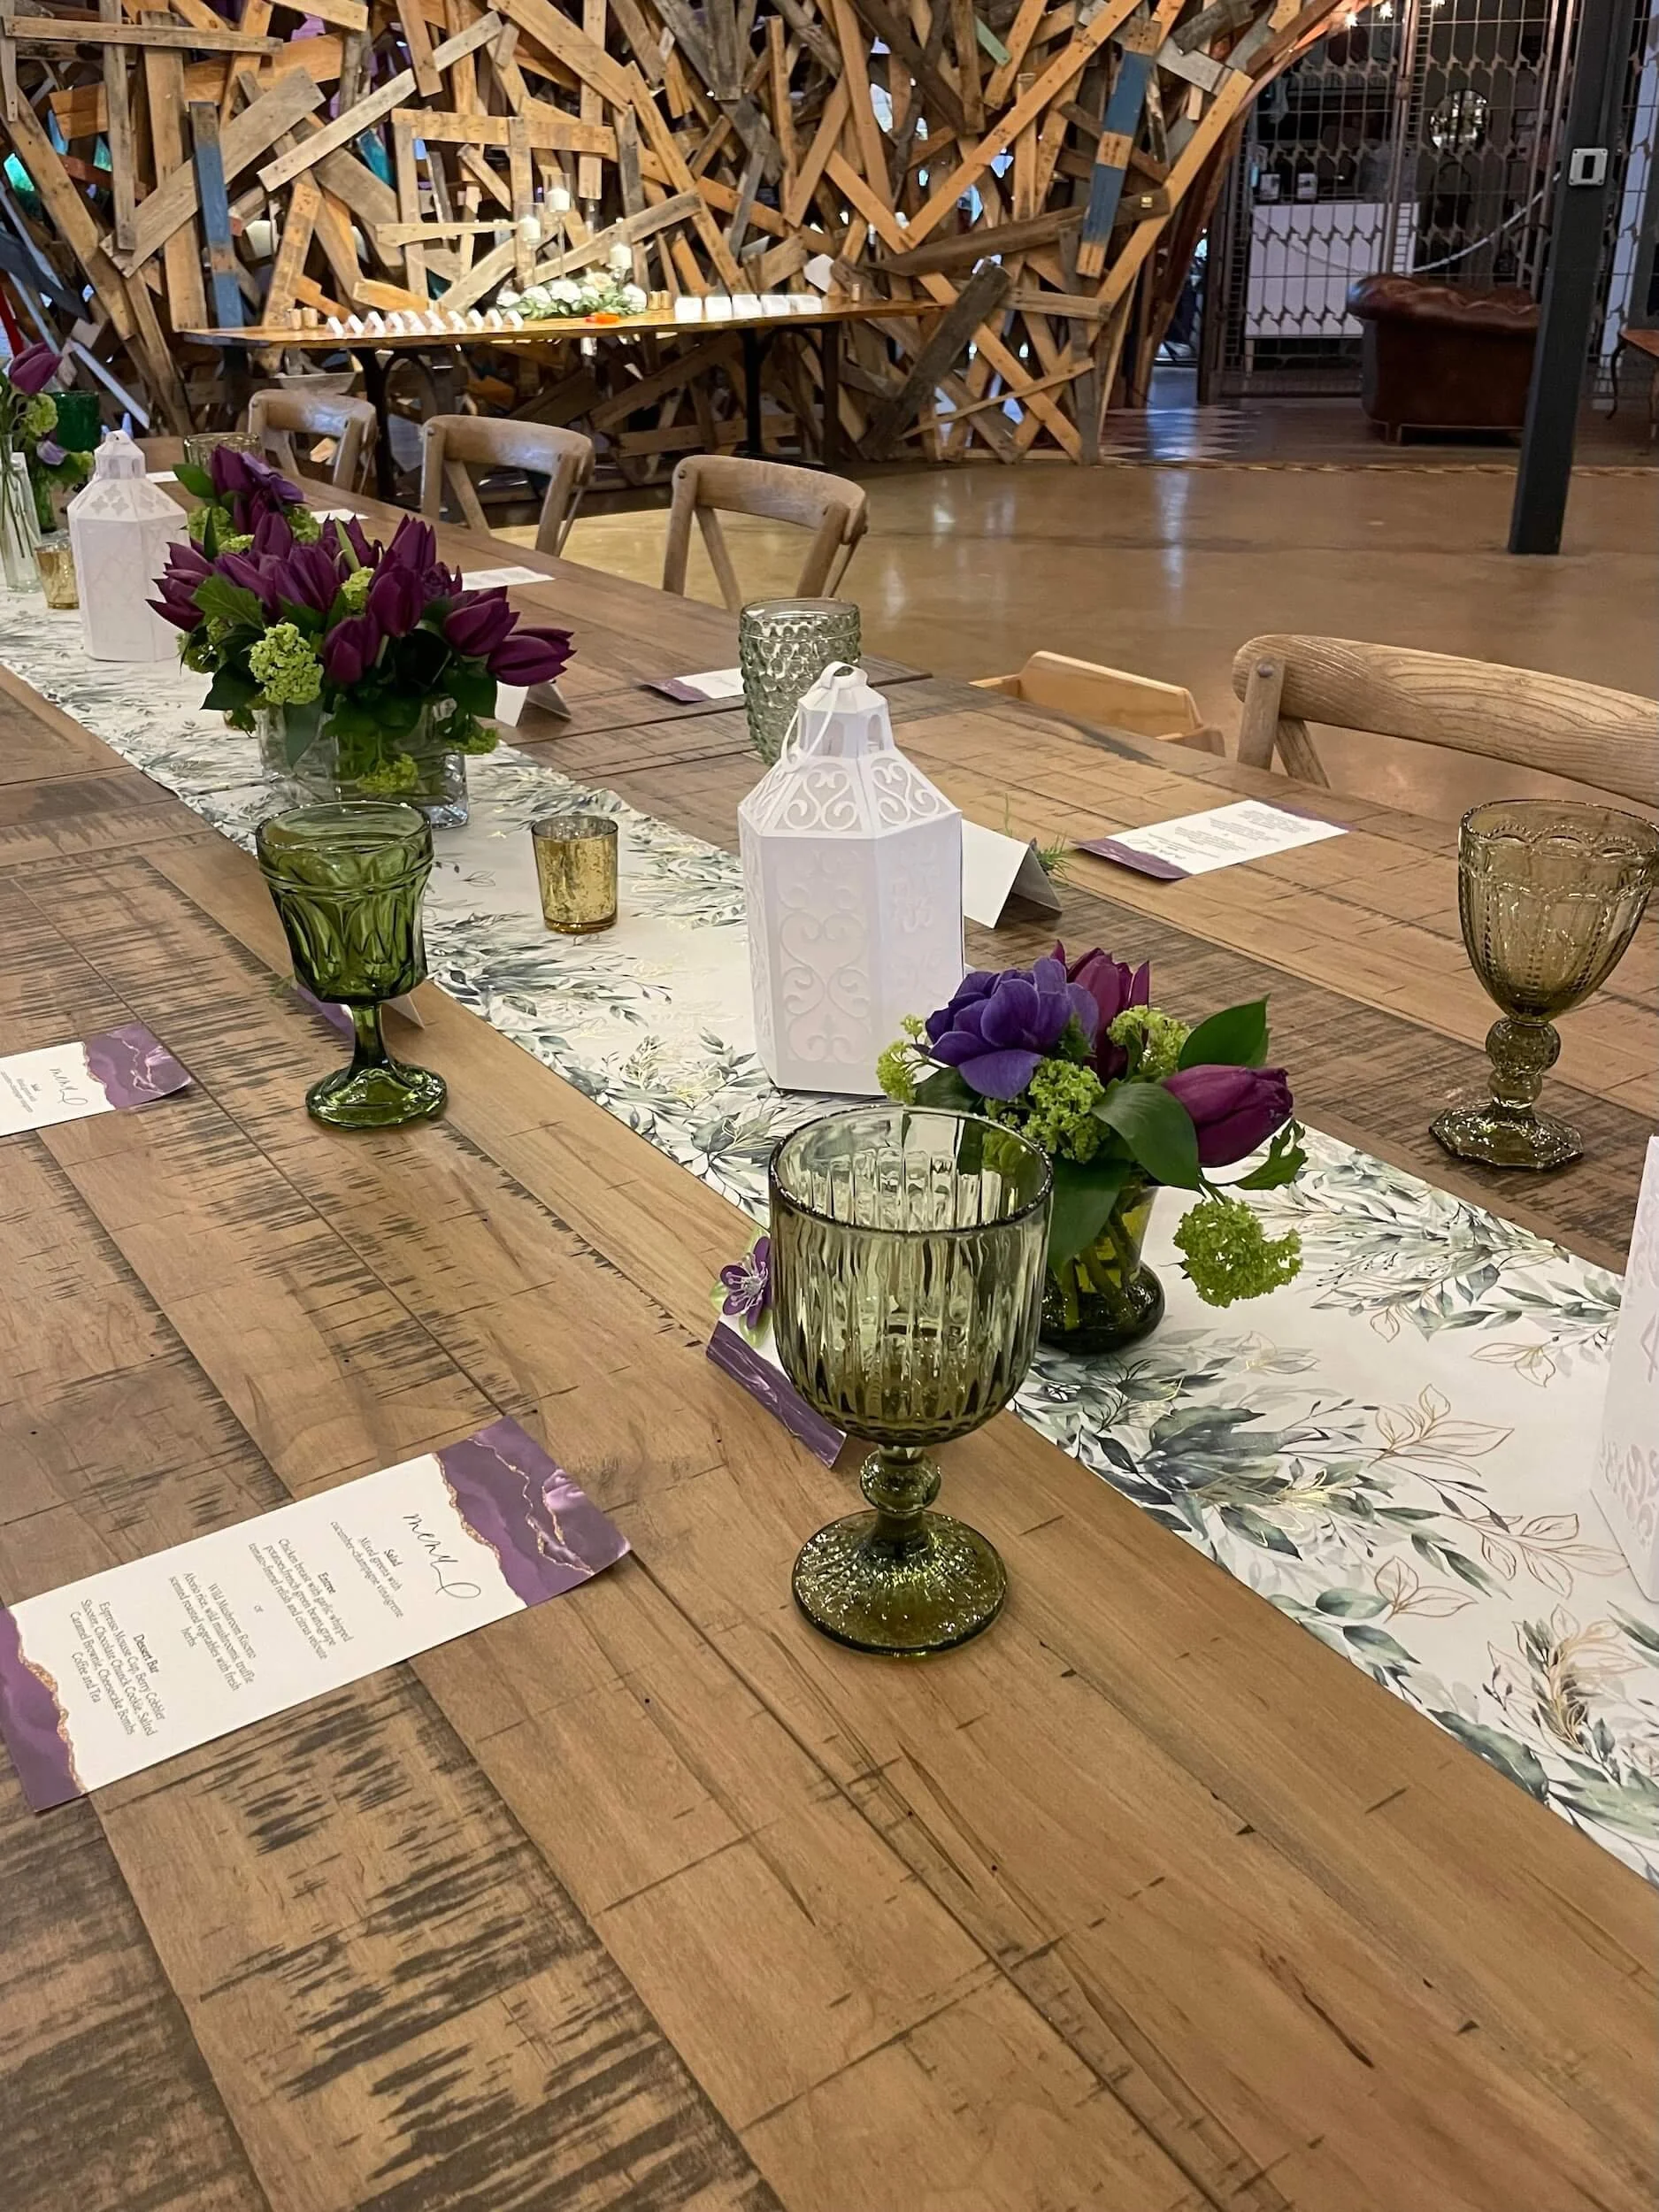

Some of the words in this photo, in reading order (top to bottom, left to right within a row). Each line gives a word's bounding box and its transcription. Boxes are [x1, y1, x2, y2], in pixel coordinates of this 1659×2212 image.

[208, 1583, 225, 1601] Wild
[278, 1539, 298, 1563] Chicken
[294, 1562, 311, 1583] breast
[307, 1581, 323, 1597] with
[329, 1614, 354, 1642] whipped
[292, 1591, 311, 1609] green
[181, 1600, 204, 1624] roasted
[216, 1599, 242, 1635] Mushroom
[287, 1604, 303, 1617] and
[133, 1633, 153, 1661] Dessert
[146, 1659, 159, 1673] Bar
[191, 1623, 220, 1658] vegetables
[204, 1608, 220, 1622] wild
[235, 1661, 255, 1684] truffle
[69, 1610, 92, 1640] Caramel
[97, 1669, 124, 1710] Cheesecake
[117, 1709, 135, 1735] Bombs
[71, 1651, 88, 1676] Coffee
[98, 1601, 119, 1632] Espresso
[112, 1630, 132, 1657] Mousse
[134, 1672, 151, 1694] Berry
[145, 1692, 165, 1720] Cobbler
[216, 1656, 231, 1673] with
[81, 1676, 98, 1689] and
[92, 1626, 116, 1660] Chocolate
[137, 1711, 158, 1737] Salted
[224, 1671, 242, 1692] fresh
[88, 1687, 101, 1703] Tea
